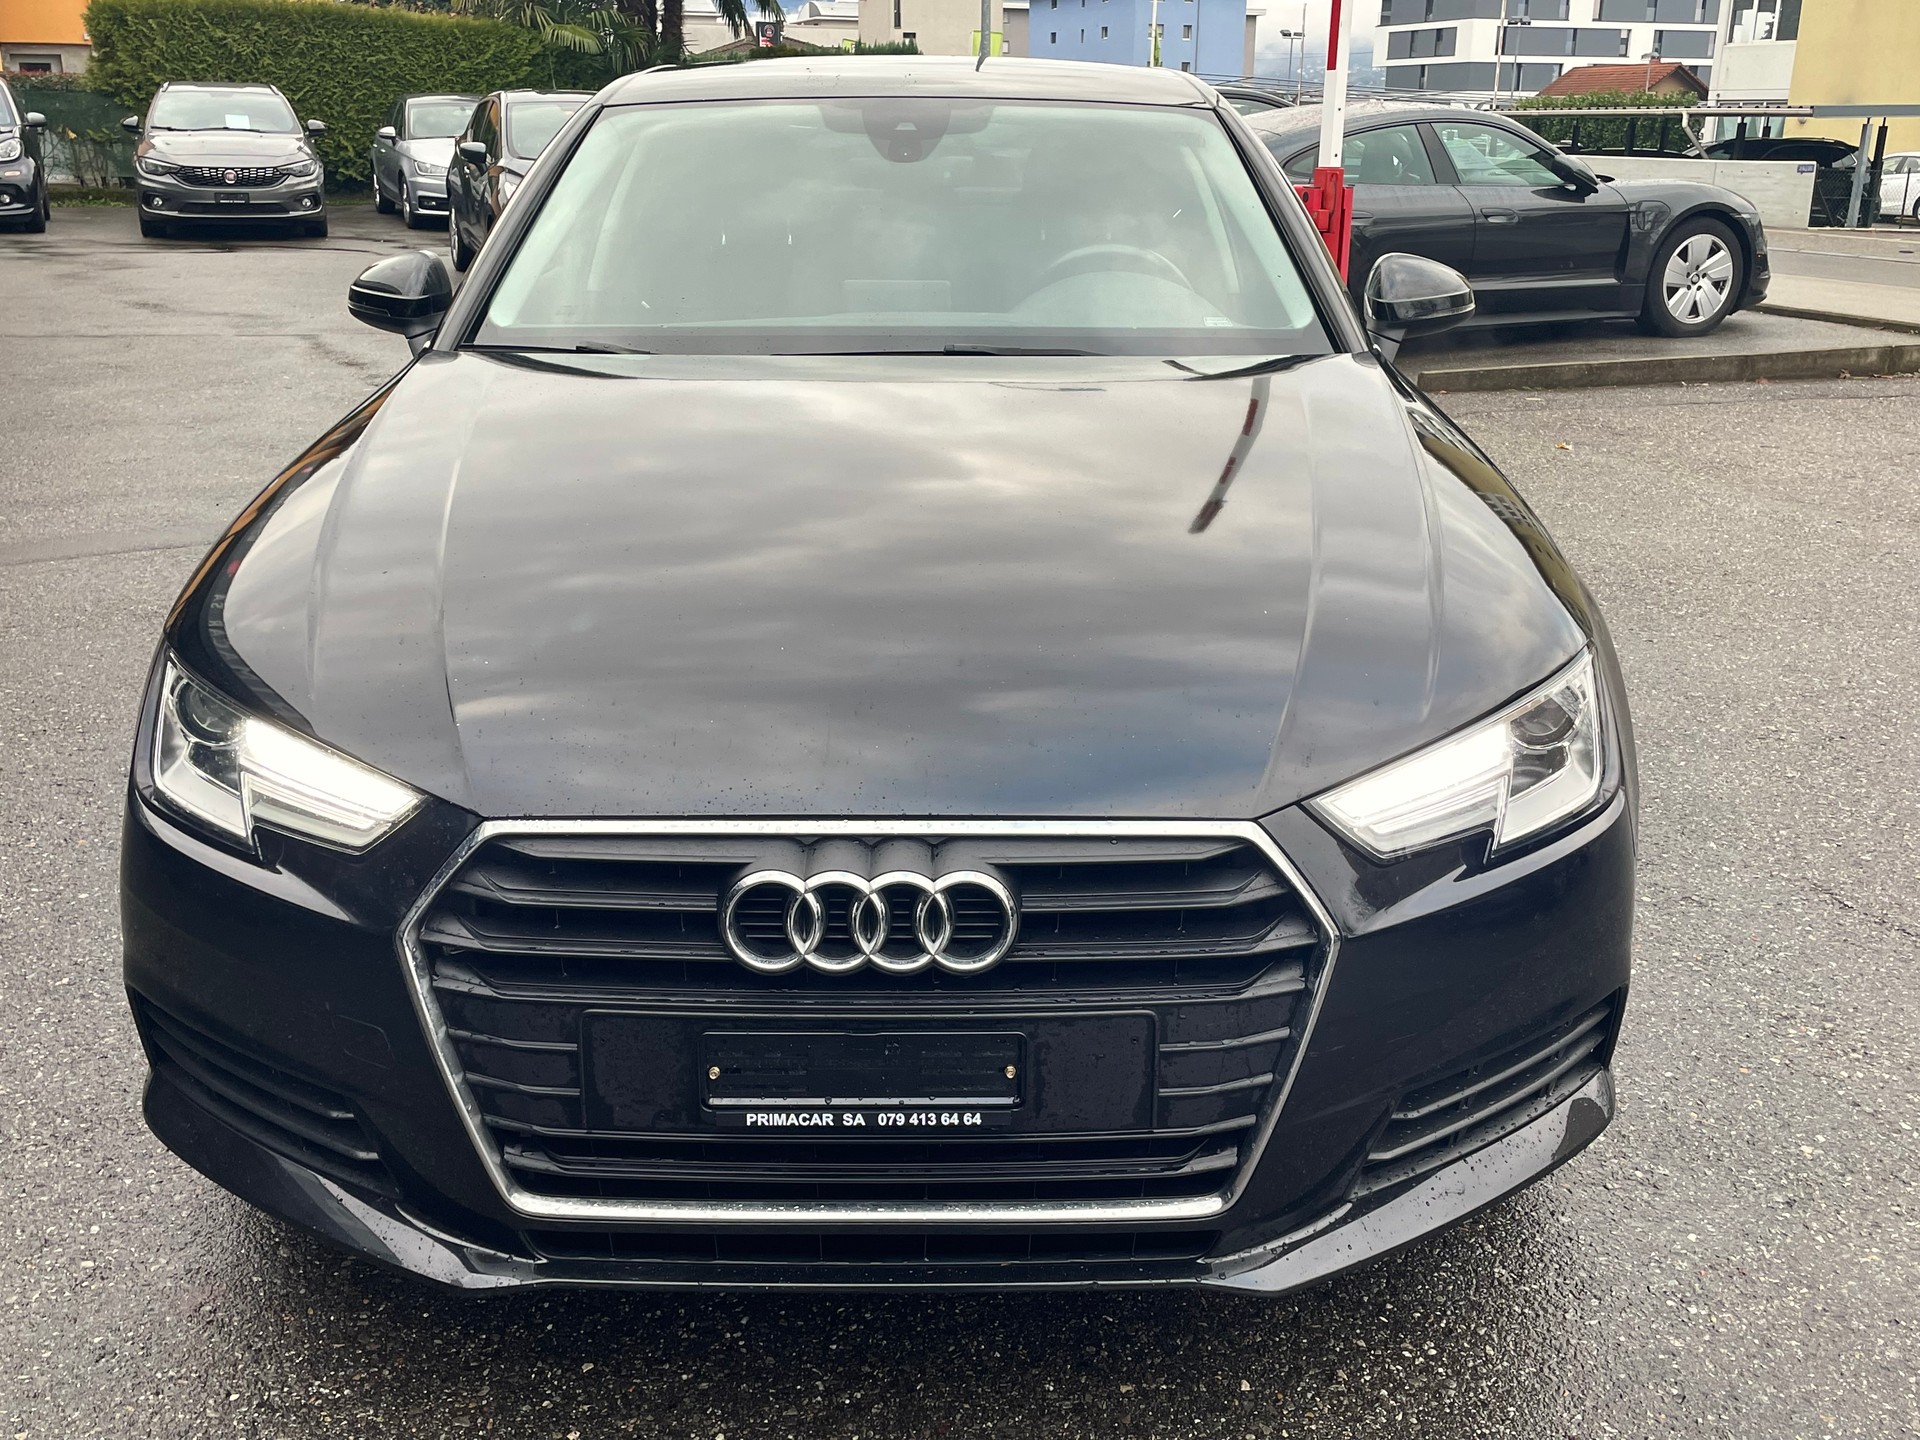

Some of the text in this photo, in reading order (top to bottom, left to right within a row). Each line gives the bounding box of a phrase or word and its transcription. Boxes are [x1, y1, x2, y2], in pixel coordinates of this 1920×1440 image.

[746, 1112, 982, 1126] PRIMACAR SA 079 413 64 64
